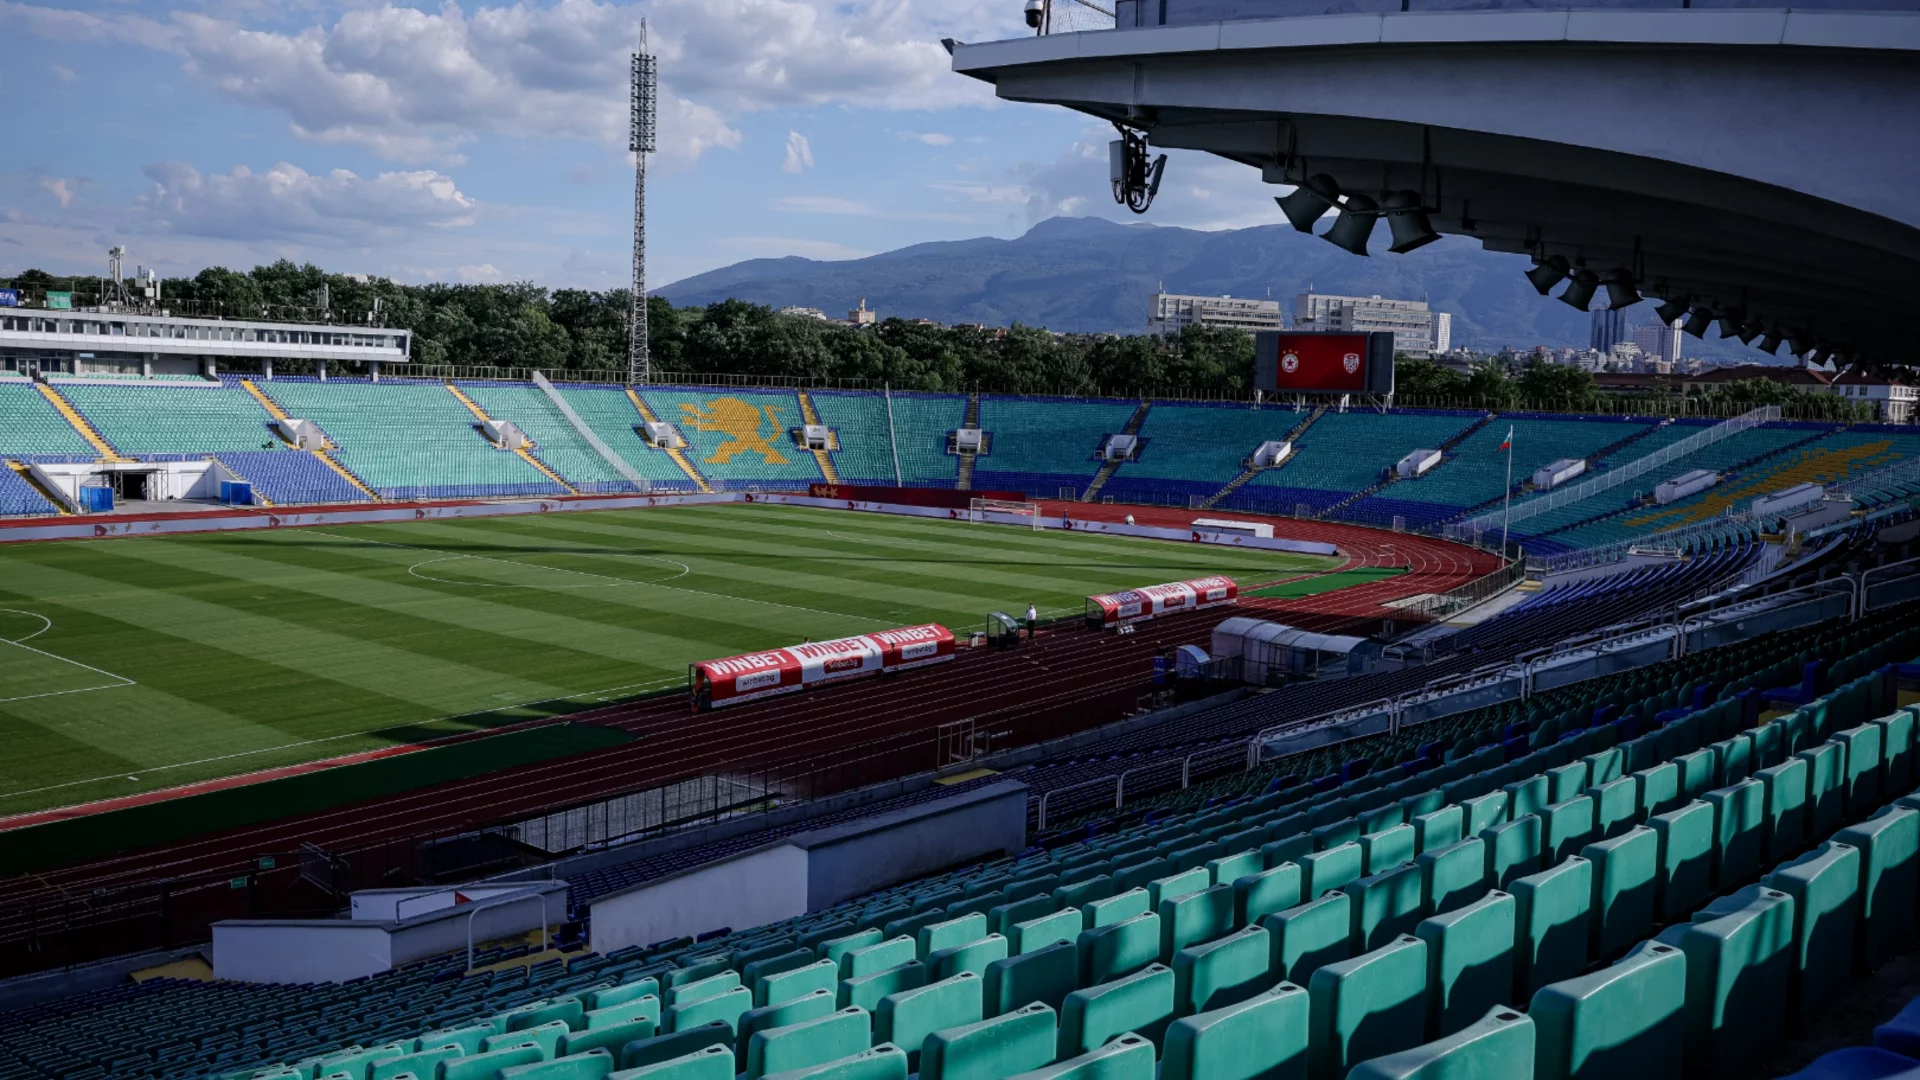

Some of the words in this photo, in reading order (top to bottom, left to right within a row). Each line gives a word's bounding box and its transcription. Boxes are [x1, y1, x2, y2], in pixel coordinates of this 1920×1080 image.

[1146, 583, 1188, 597] WINBET
[1190, 576, 1227, 588] WINBET
[873, 625, 942, 645] WINBET
[794, 637, 871, 659] WINBET
[704, 652, 787, 675] WINBET
[742, 674, 775, 687] winbet.bg
